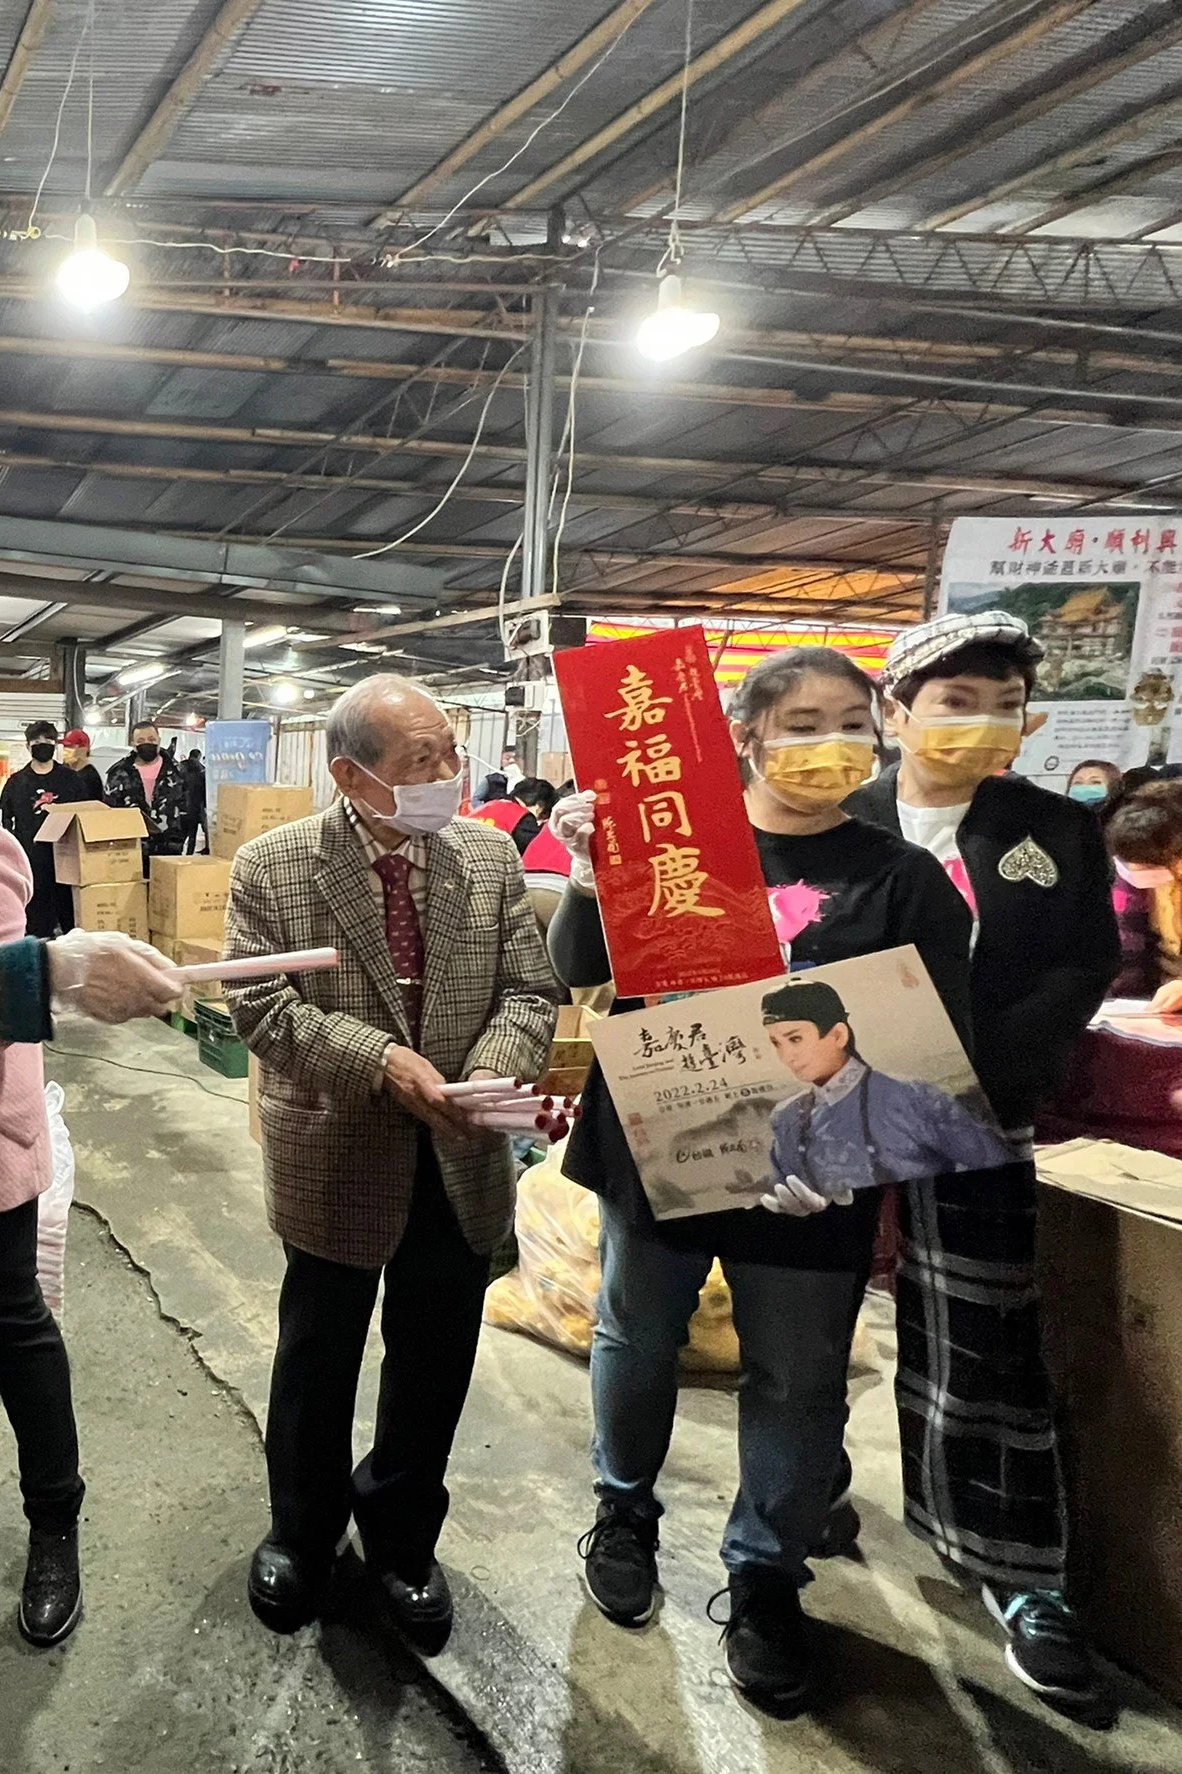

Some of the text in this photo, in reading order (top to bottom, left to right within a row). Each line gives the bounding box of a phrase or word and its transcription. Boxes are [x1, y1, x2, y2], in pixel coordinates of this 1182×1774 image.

[603, 664, 726, 918] 嘉福同慶
[653, 1077, 730, 1103] 2022.2.24
